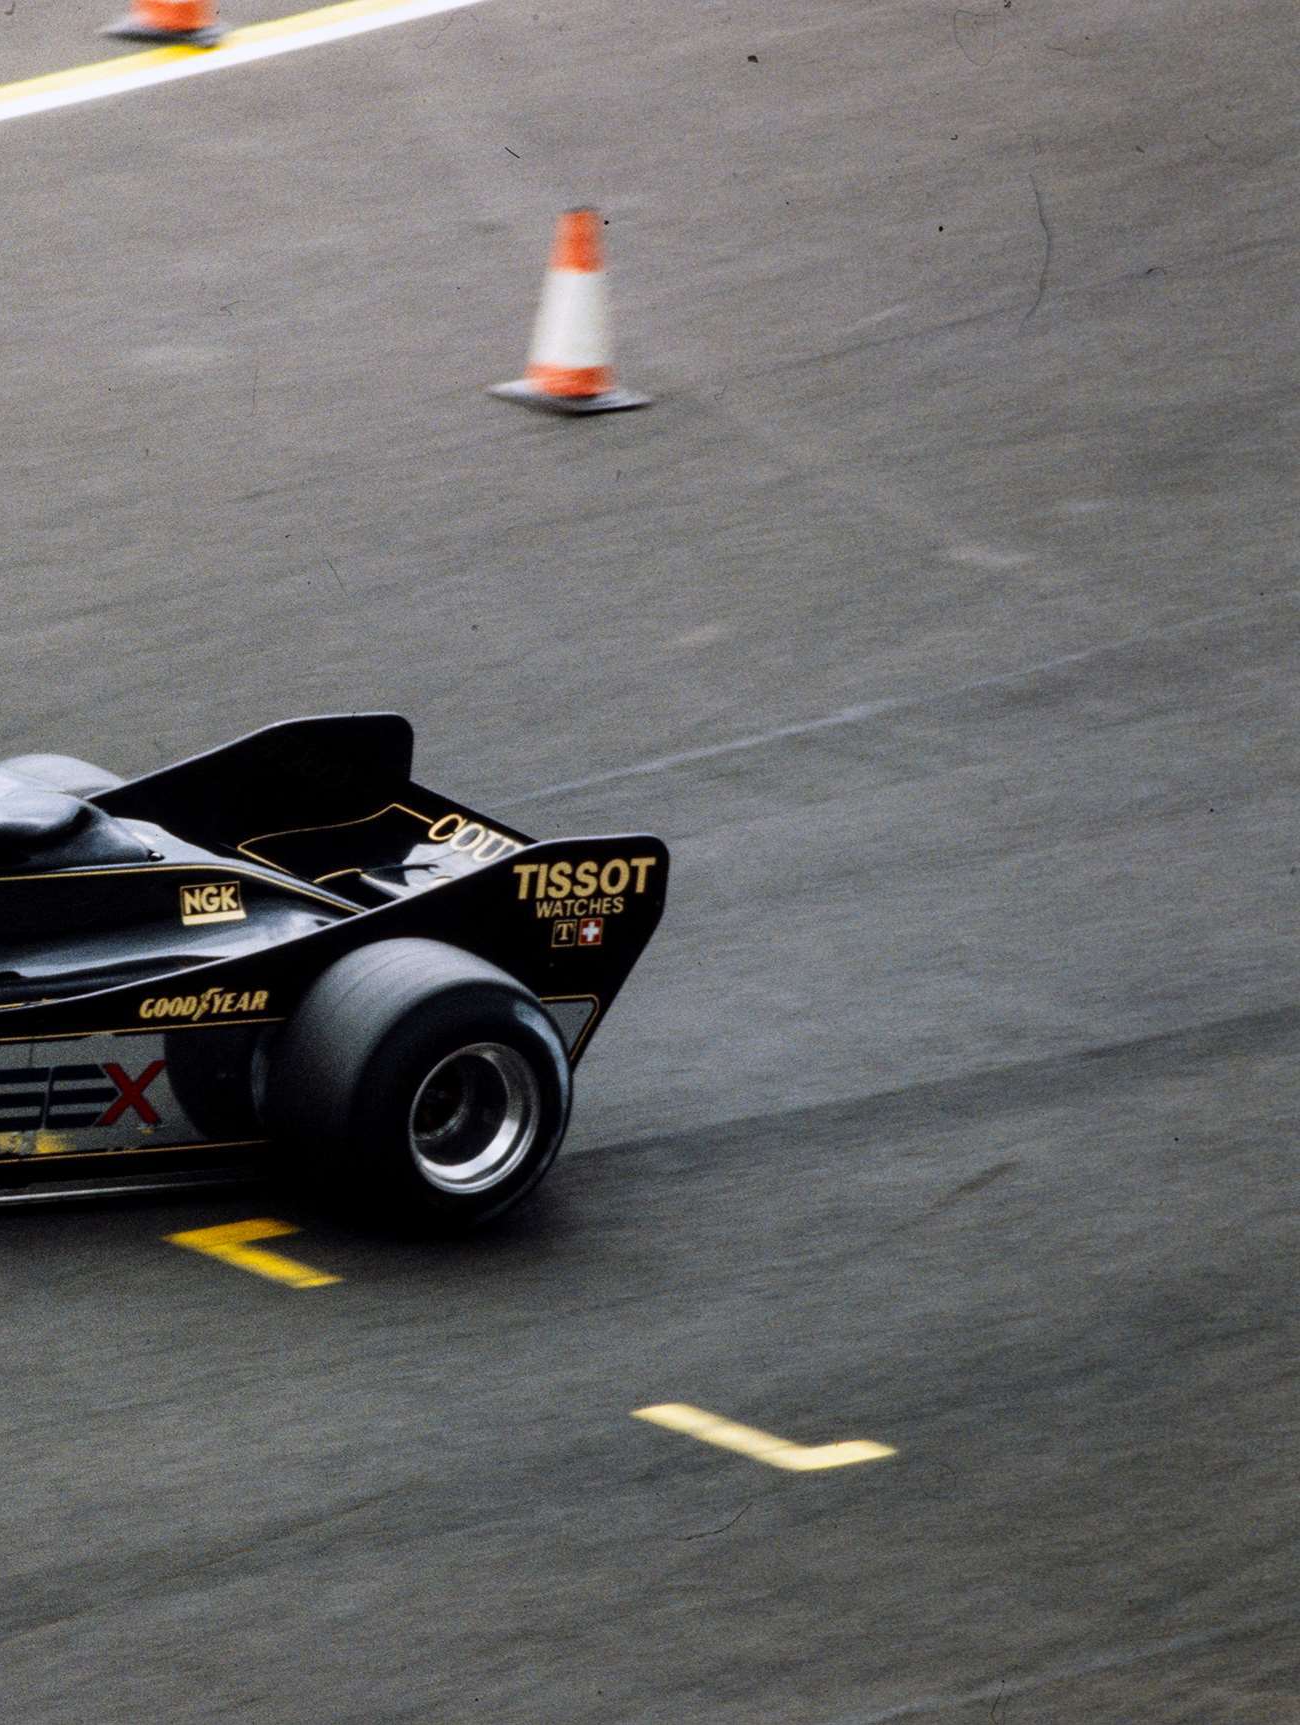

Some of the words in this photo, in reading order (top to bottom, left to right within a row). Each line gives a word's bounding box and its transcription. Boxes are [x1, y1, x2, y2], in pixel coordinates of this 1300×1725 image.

[428, 813, 524, 862] COU
[513, 857, 656, 900] TISSOT
[183, 886, 238, 914] NGK
[536, 897, 624, 919] WATCHES
[139, 987, 269, 1021] GOODYEAR
